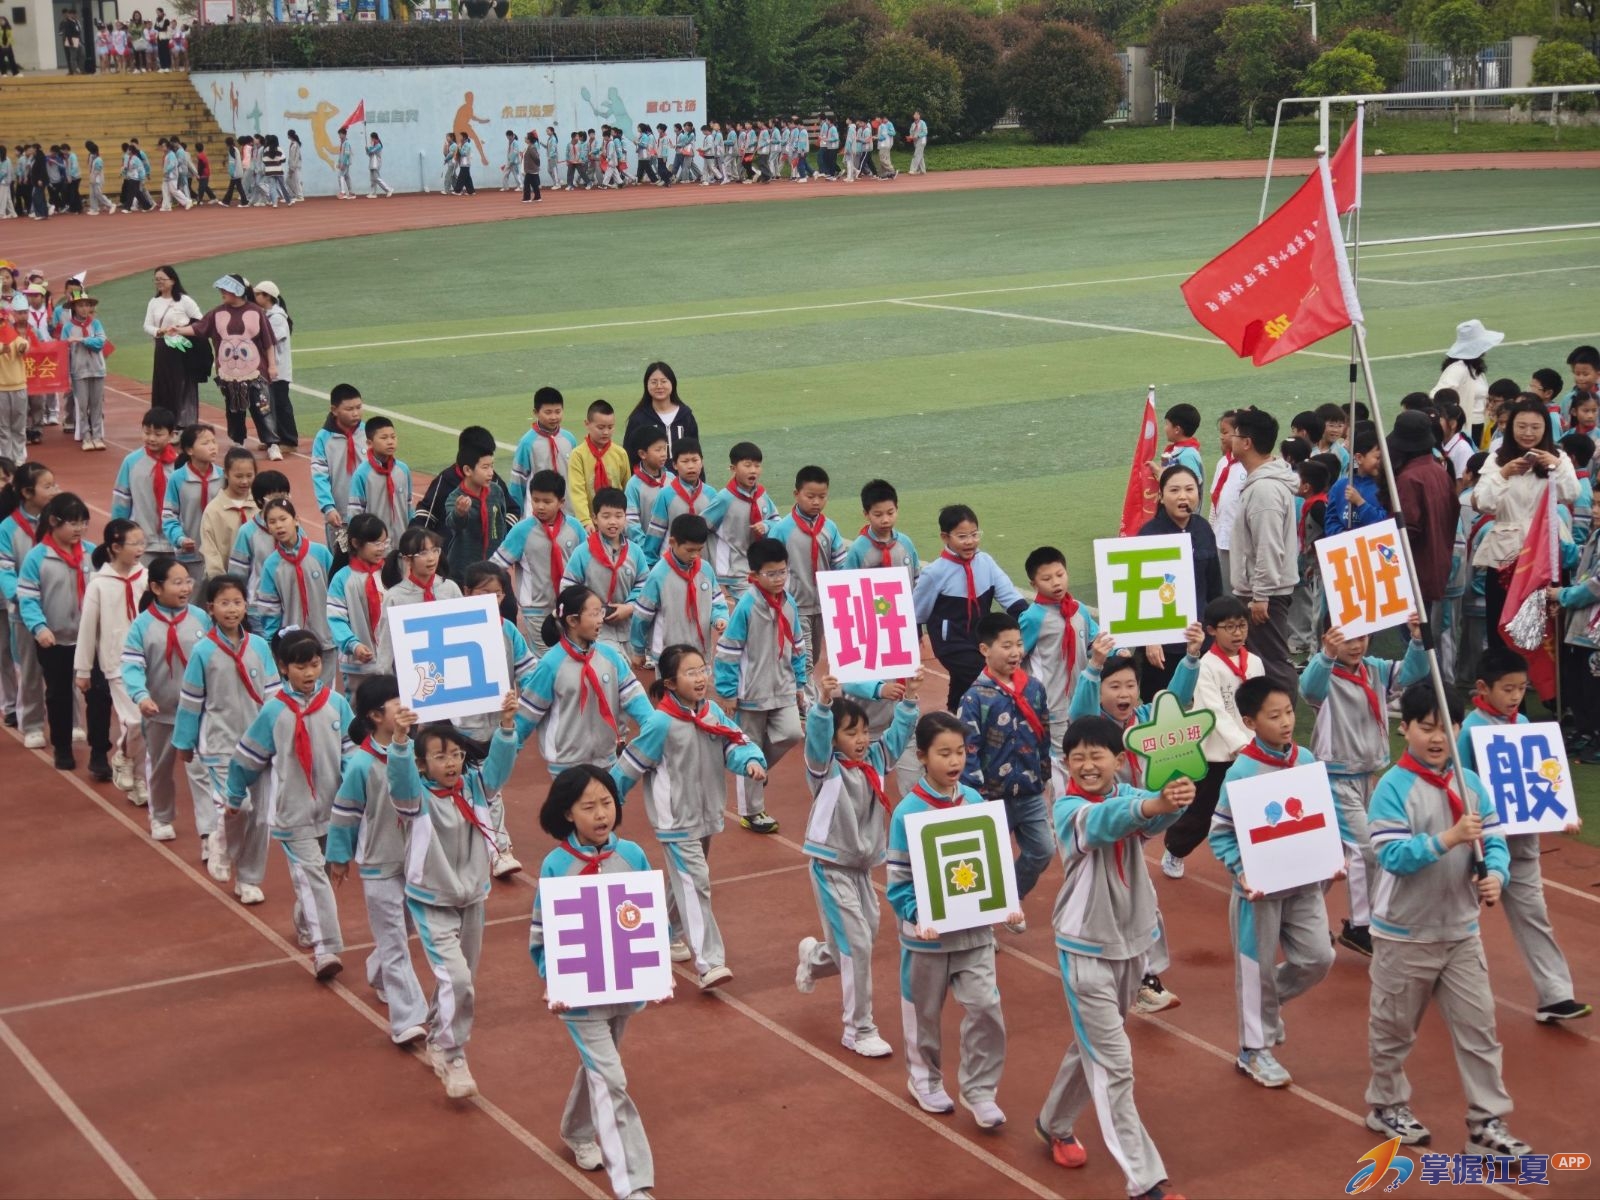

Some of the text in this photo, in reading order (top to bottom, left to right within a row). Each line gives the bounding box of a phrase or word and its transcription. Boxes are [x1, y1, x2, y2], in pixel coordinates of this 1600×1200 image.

[827, 577, 912, 670] 班
[1106, 547, 1188, 634] 五
[1326, 533, 1408, 624] 班
[403, 609, 499, 707] 五
[1486, 733, 1568, 824] 般
[920, 815, 1008, 921] 同
[553, 884, 661, 993] 非
